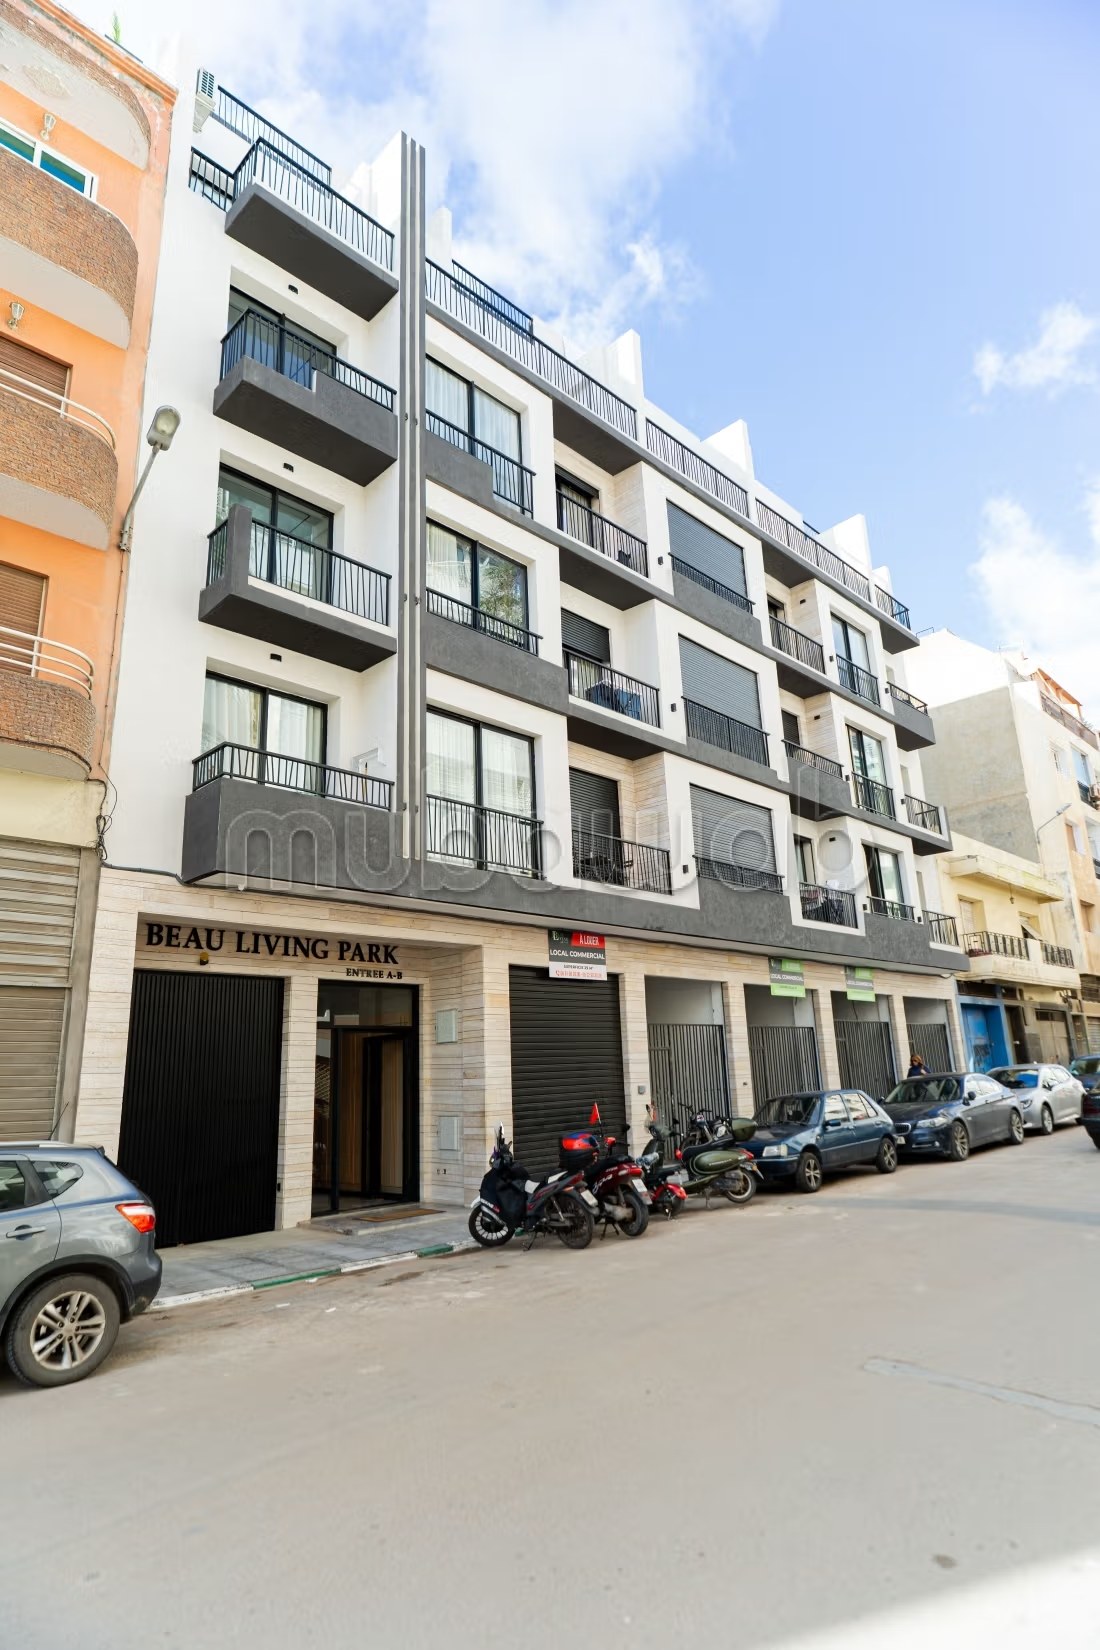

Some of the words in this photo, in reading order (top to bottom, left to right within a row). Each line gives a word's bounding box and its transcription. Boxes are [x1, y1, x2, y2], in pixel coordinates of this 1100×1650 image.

[145, 922, 226, 951] BEAU
[235, 931, 330, 960] LIVING
[338, 941, 400, 965] PARK
[584, 936, 600, 946] LOUER
[570, 950, 605, 960] COMMERCIAL
[345, 967, 384, 979] ENTREE
[386, 970, 403, 980] A-B
